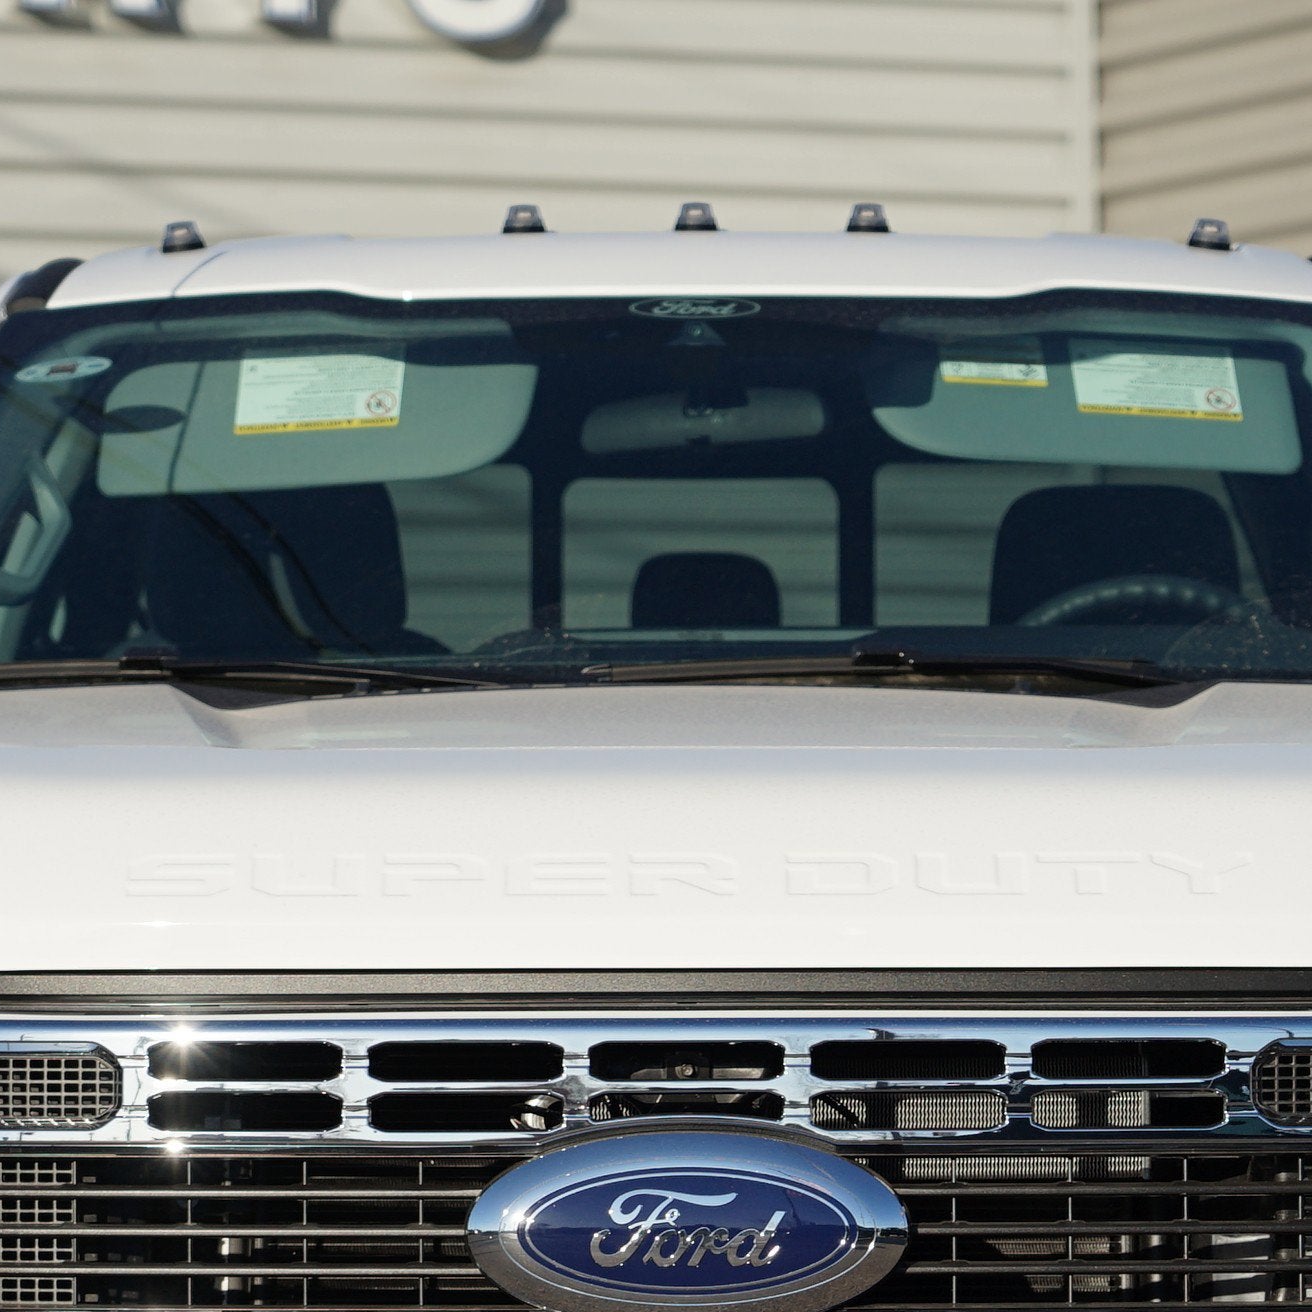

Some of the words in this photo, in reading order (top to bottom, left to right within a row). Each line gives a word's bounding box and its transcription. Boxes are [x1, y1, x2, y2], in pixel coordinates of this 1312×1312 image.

[652, 299, 737, 315] Ford
[123, 852, 740, 898] SUPER
[783, 852, 1254, 897] DUTY
[589, 1188, 787, 1268] Ford
